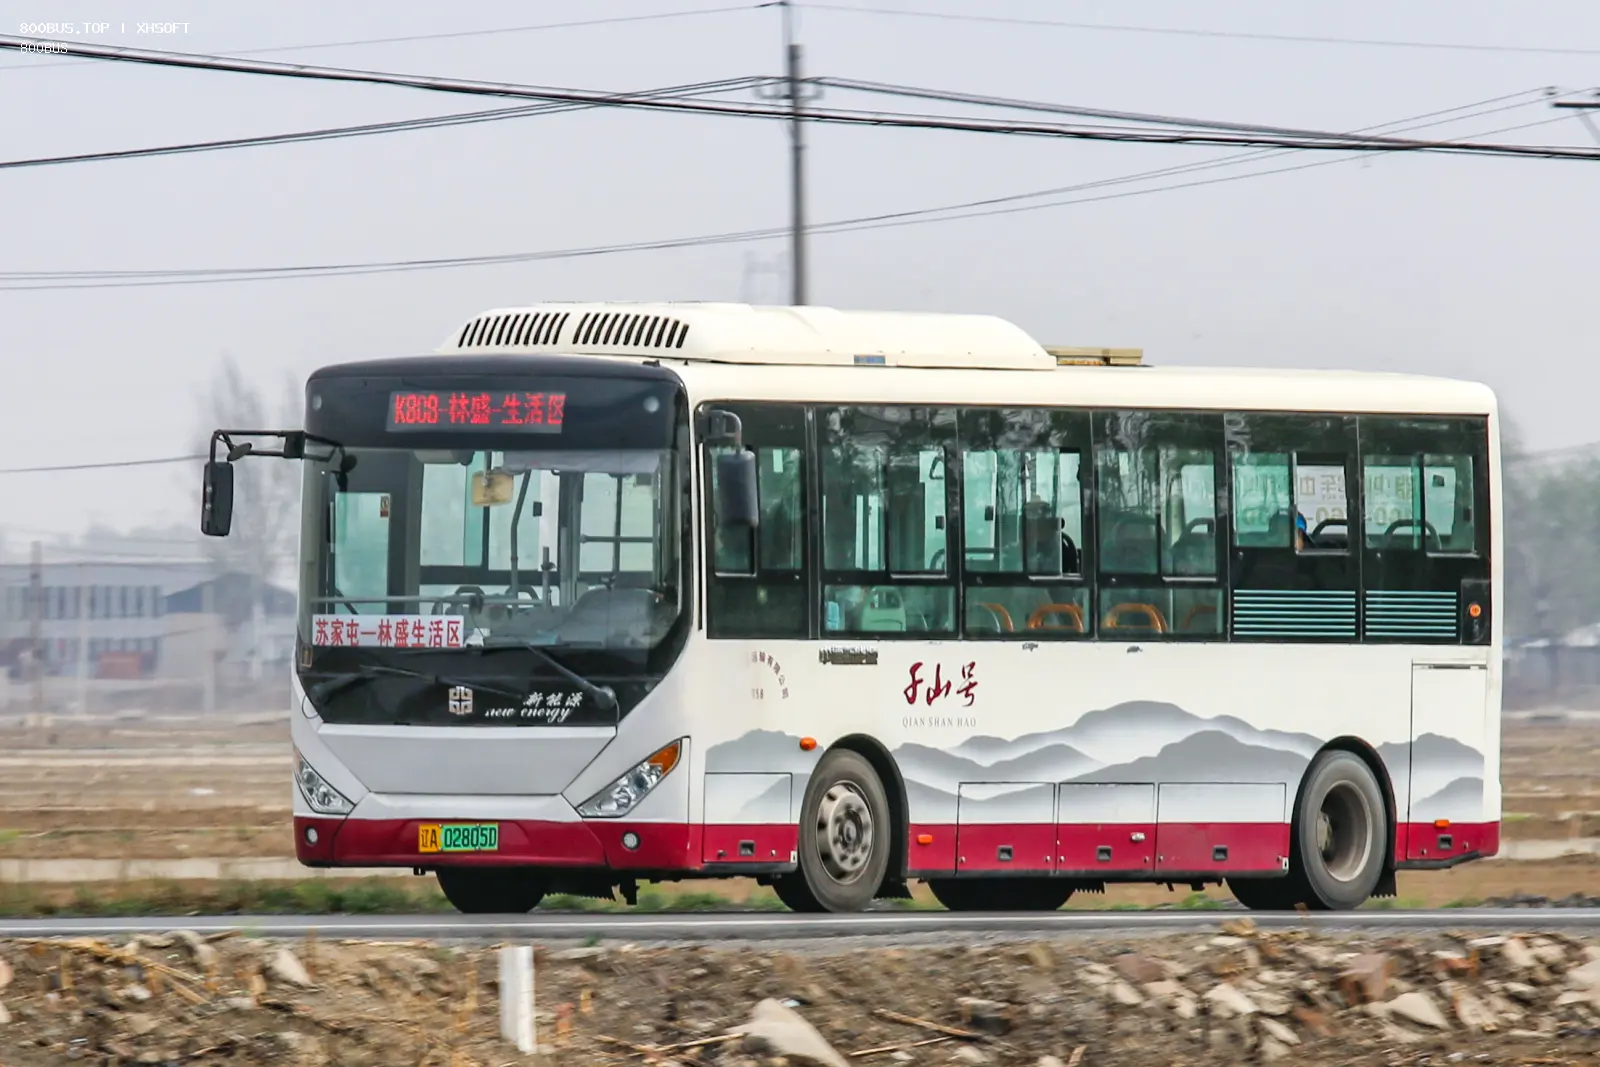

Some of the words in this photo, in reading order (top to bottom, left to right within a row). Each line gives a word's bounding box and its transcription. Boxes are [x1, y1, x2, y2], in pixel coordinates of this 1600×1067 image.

[903, 661, 979, 707] 千山号
[523, 692, 583, 707] 新能源
[485, 706, 517, 717] new
[520, 705, 572, 723] energy
[902, 716, 925, 729] QIAN
[928, 716, 953, 728] SHAN
[957, 716, 977, 728] HAO
